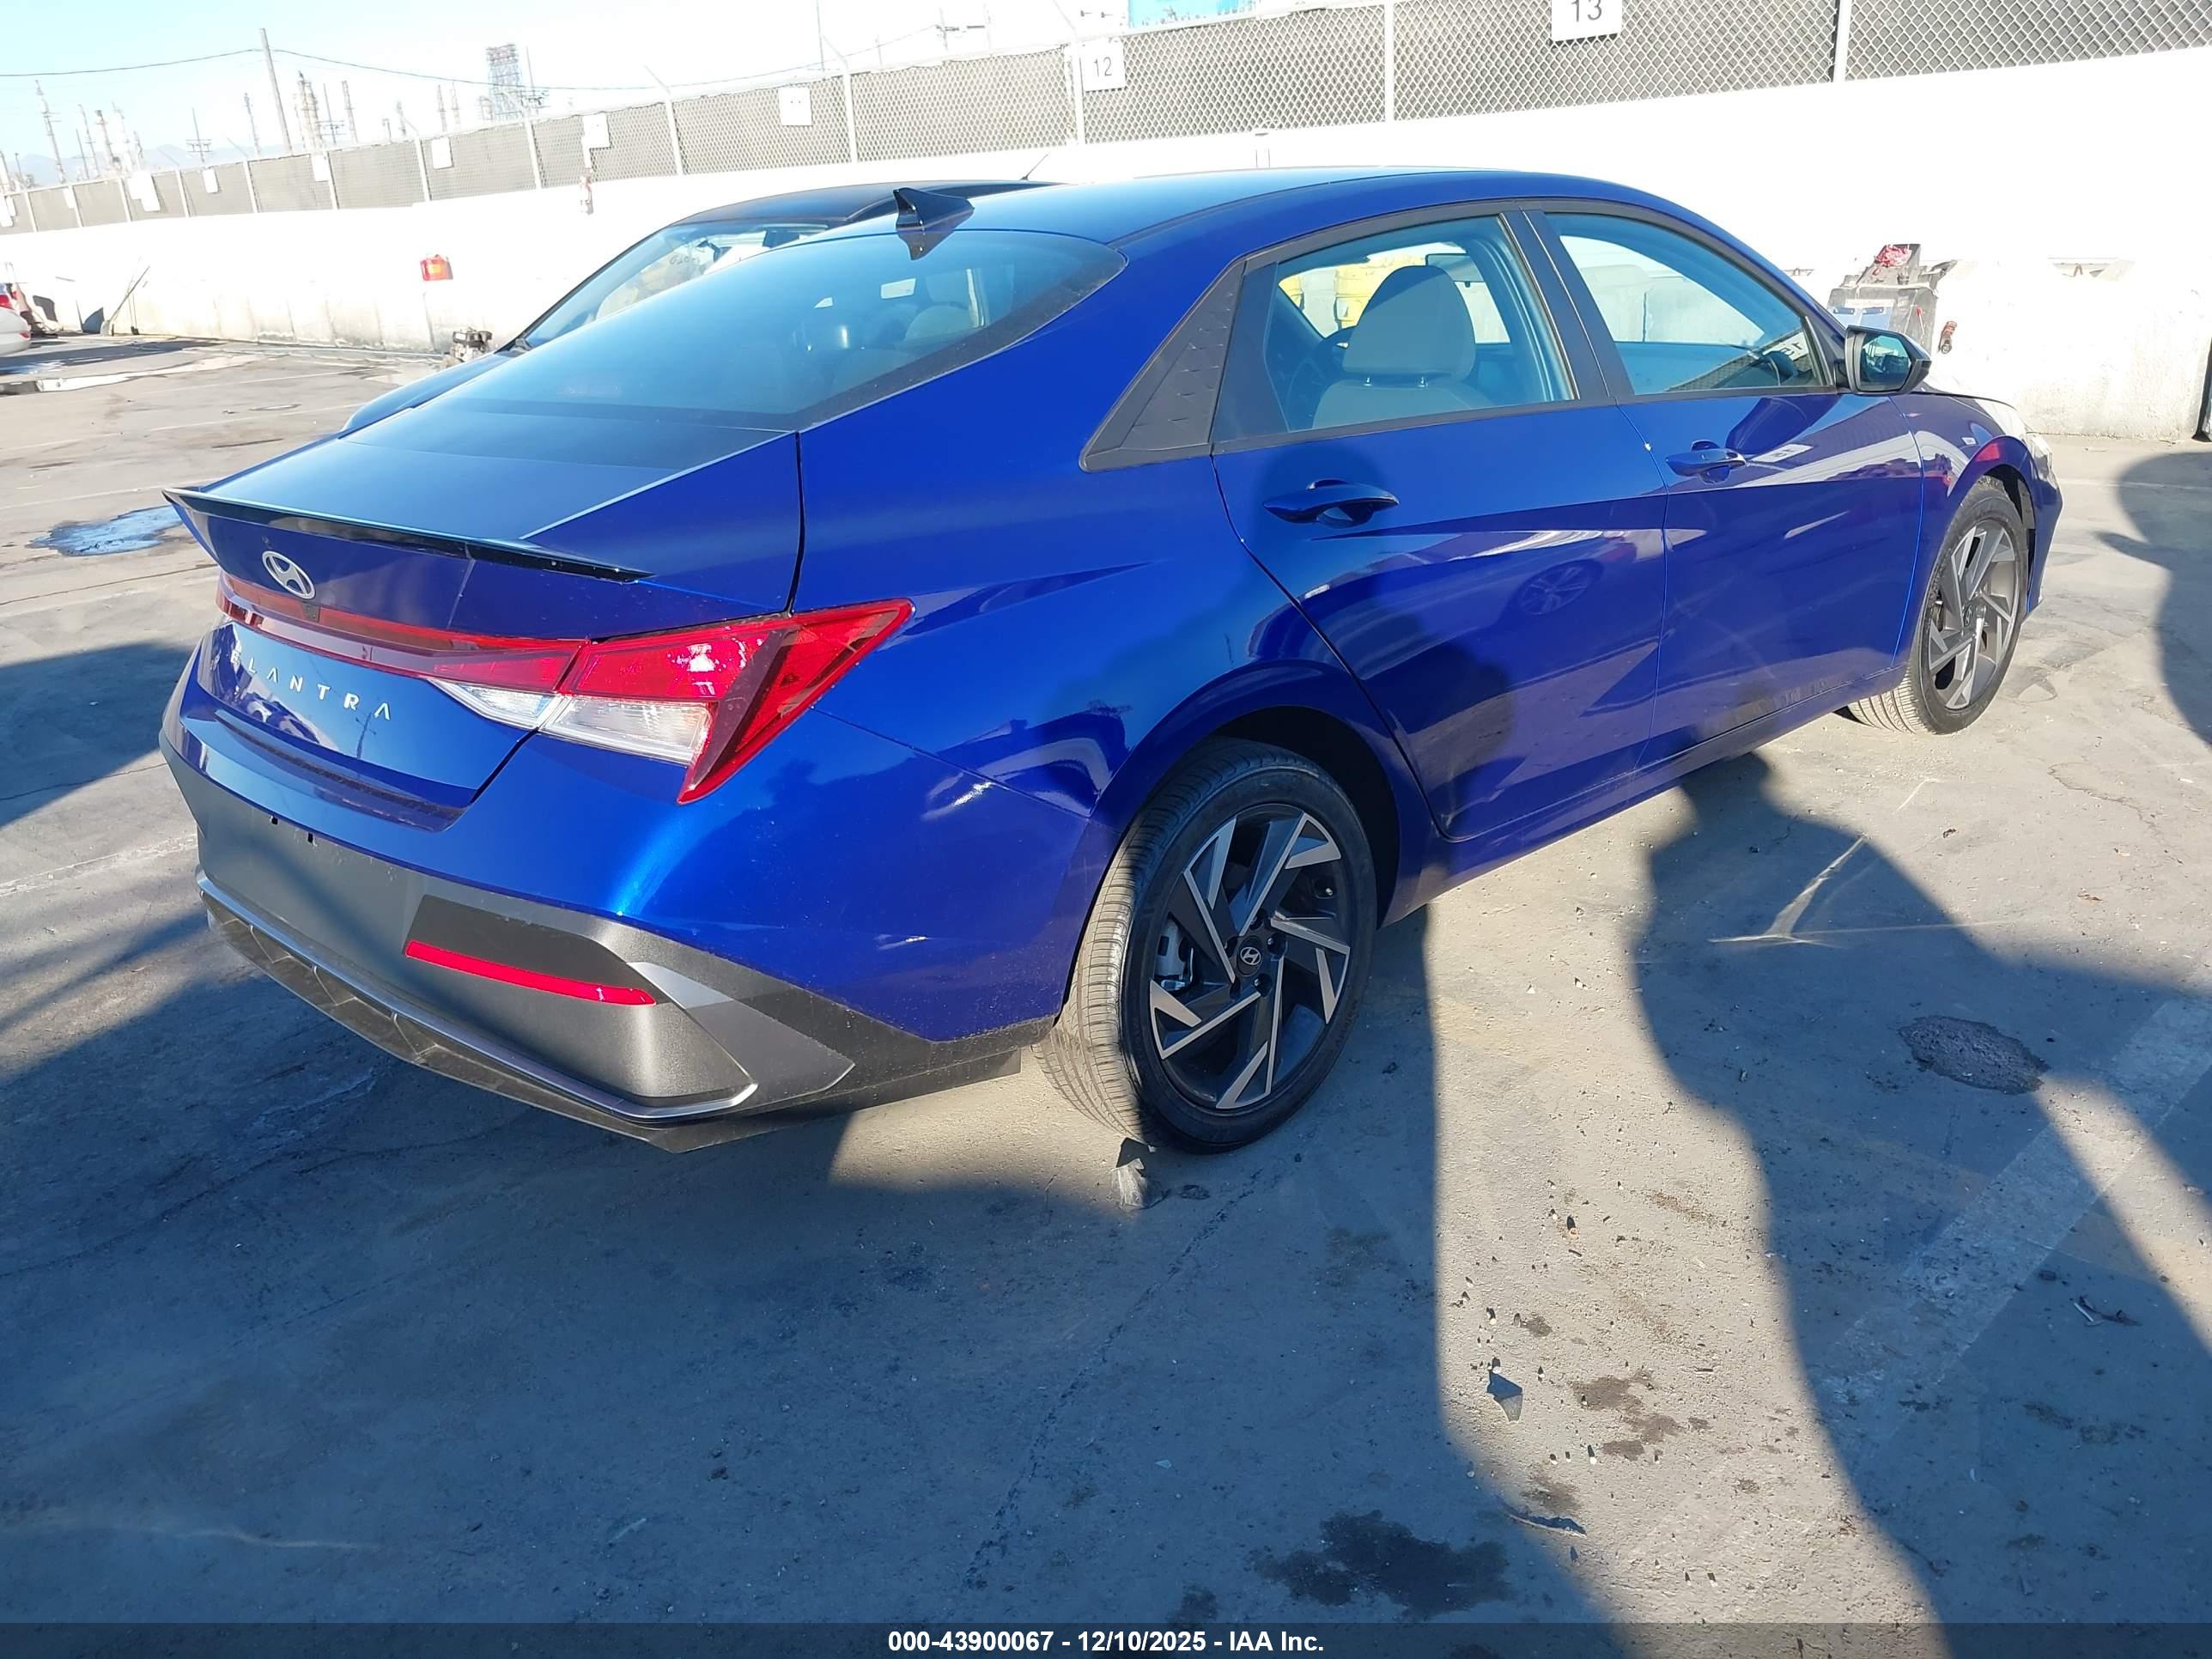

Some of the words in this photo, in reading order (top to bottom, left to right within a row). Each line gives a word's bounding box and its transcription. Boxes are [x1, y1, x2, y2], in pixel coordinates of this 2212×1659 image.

[1571, 0, 1602, 23] 13
[1093, 56, 1112, 77] 12
[230, 648, 391, 720] ELANTRA
